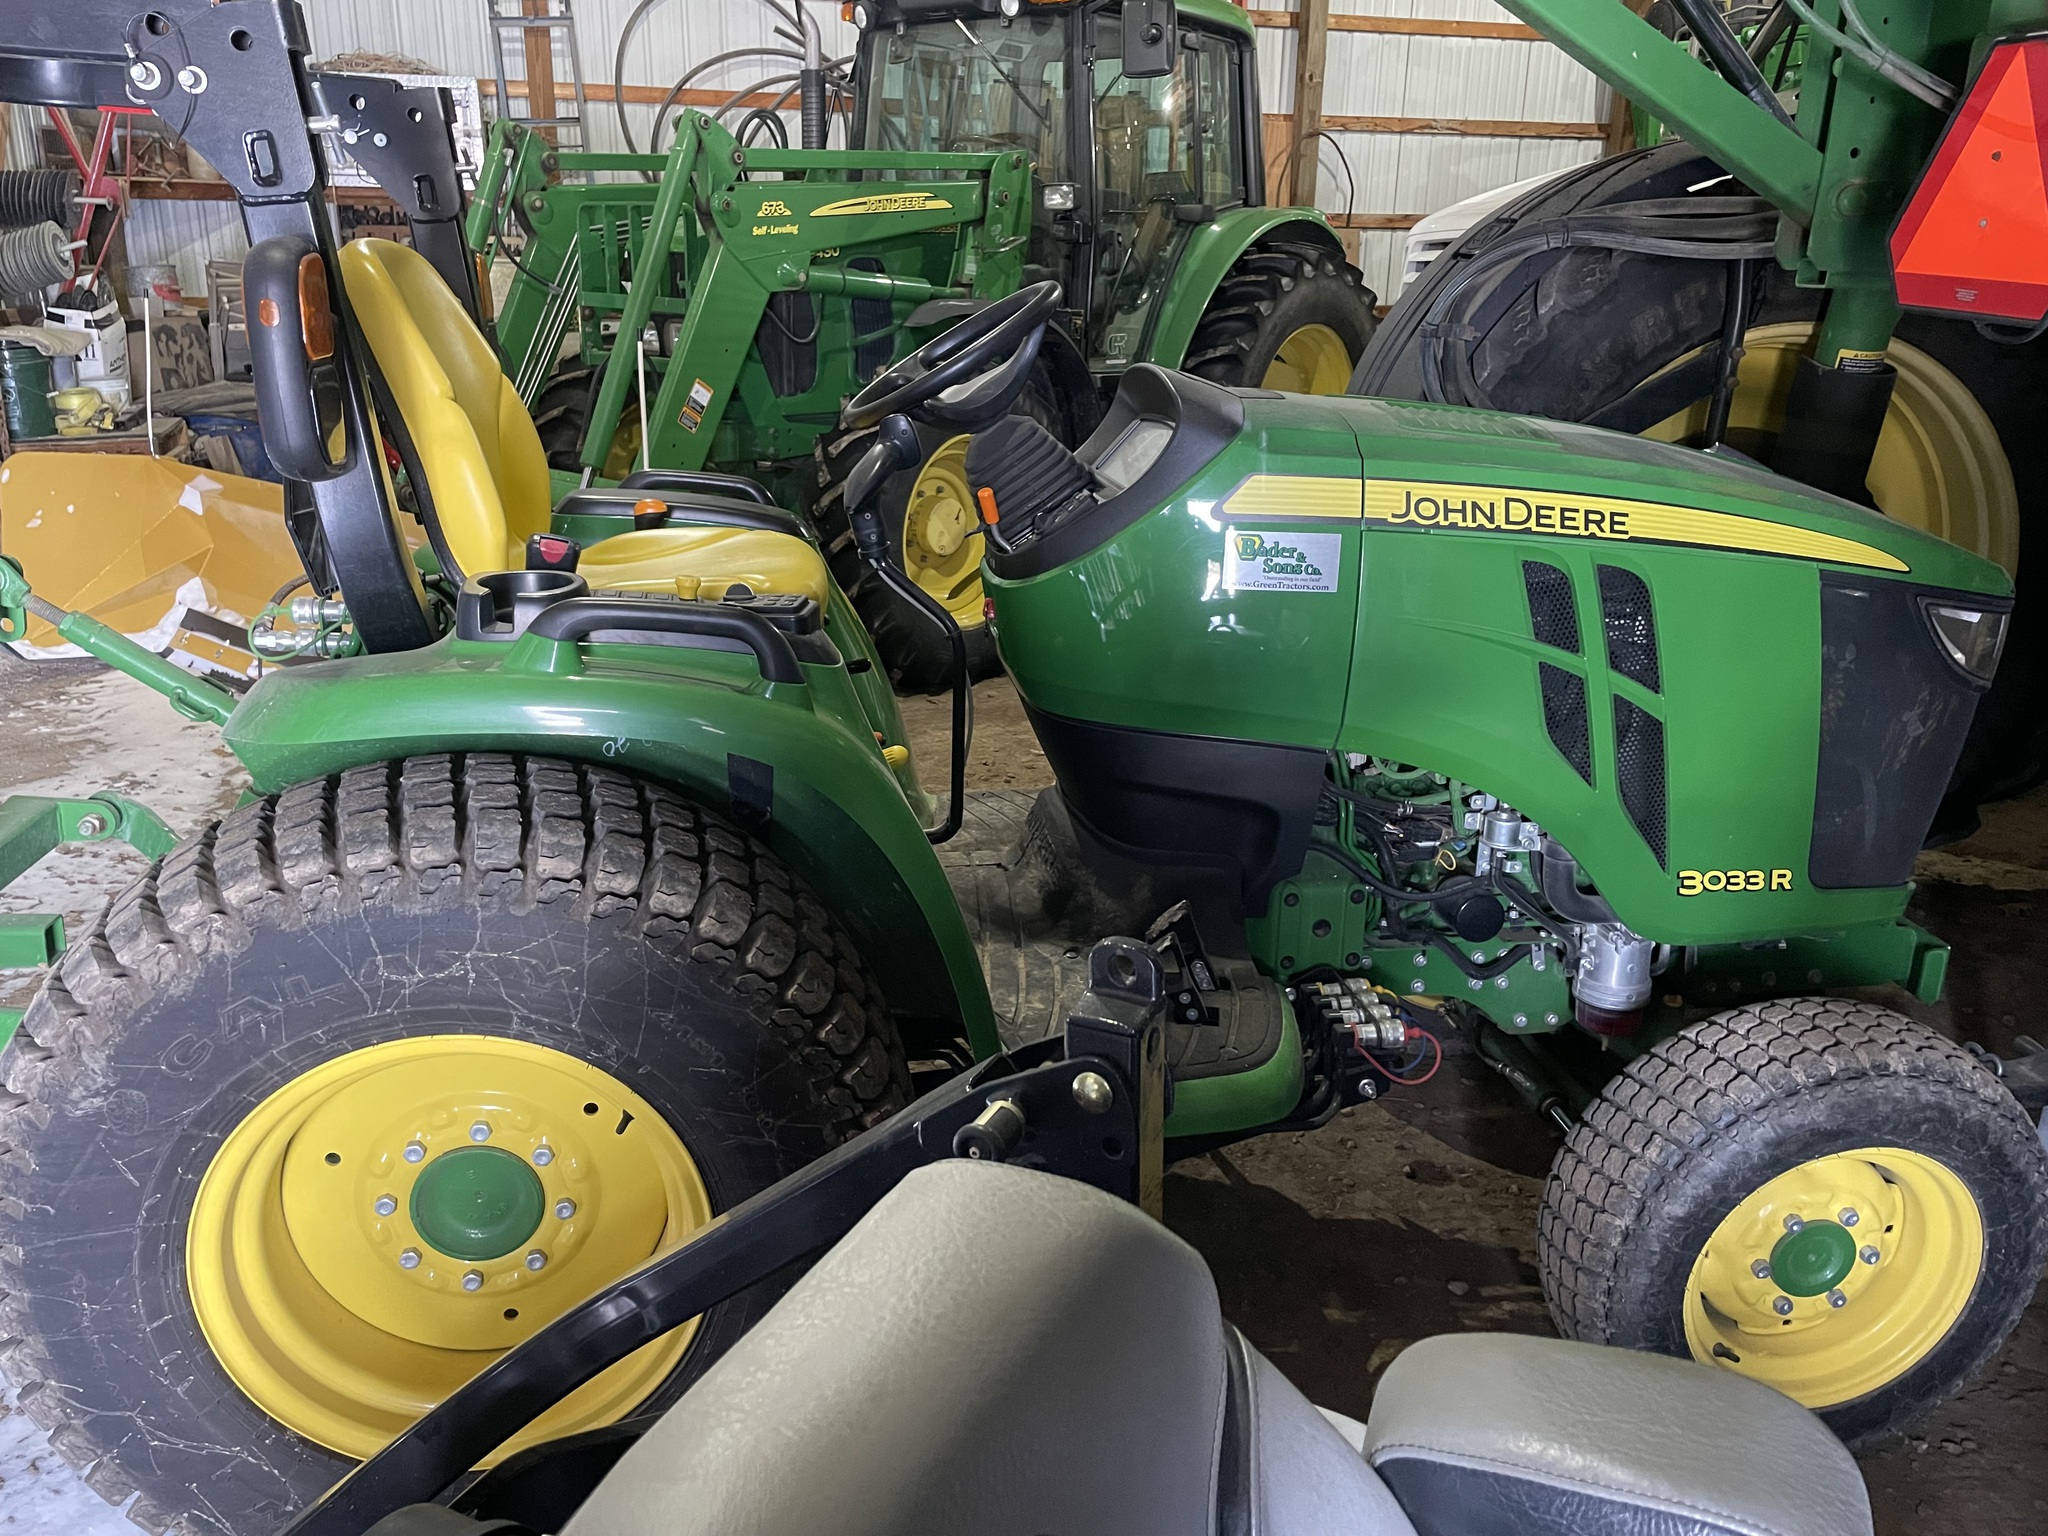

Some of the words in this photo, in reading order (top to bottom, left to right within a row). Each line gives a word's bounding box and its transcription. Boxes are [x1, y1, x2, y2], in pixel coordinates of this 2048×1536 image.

[761, 201, 785, 215] 673
[865, 198, 892, 212] JOHN
[891, 196, 927, 211] DEERE
[1390, 490, 1496, 525] JOHN
[1503, 496, 1630, 536] DEERE
[1240, 537, 1298, 559] Bader
[1295, 551, 1307, 563] &
[1262, 558, 1303, 575] Sons
[1303, 563, 1323, 576] Co.
